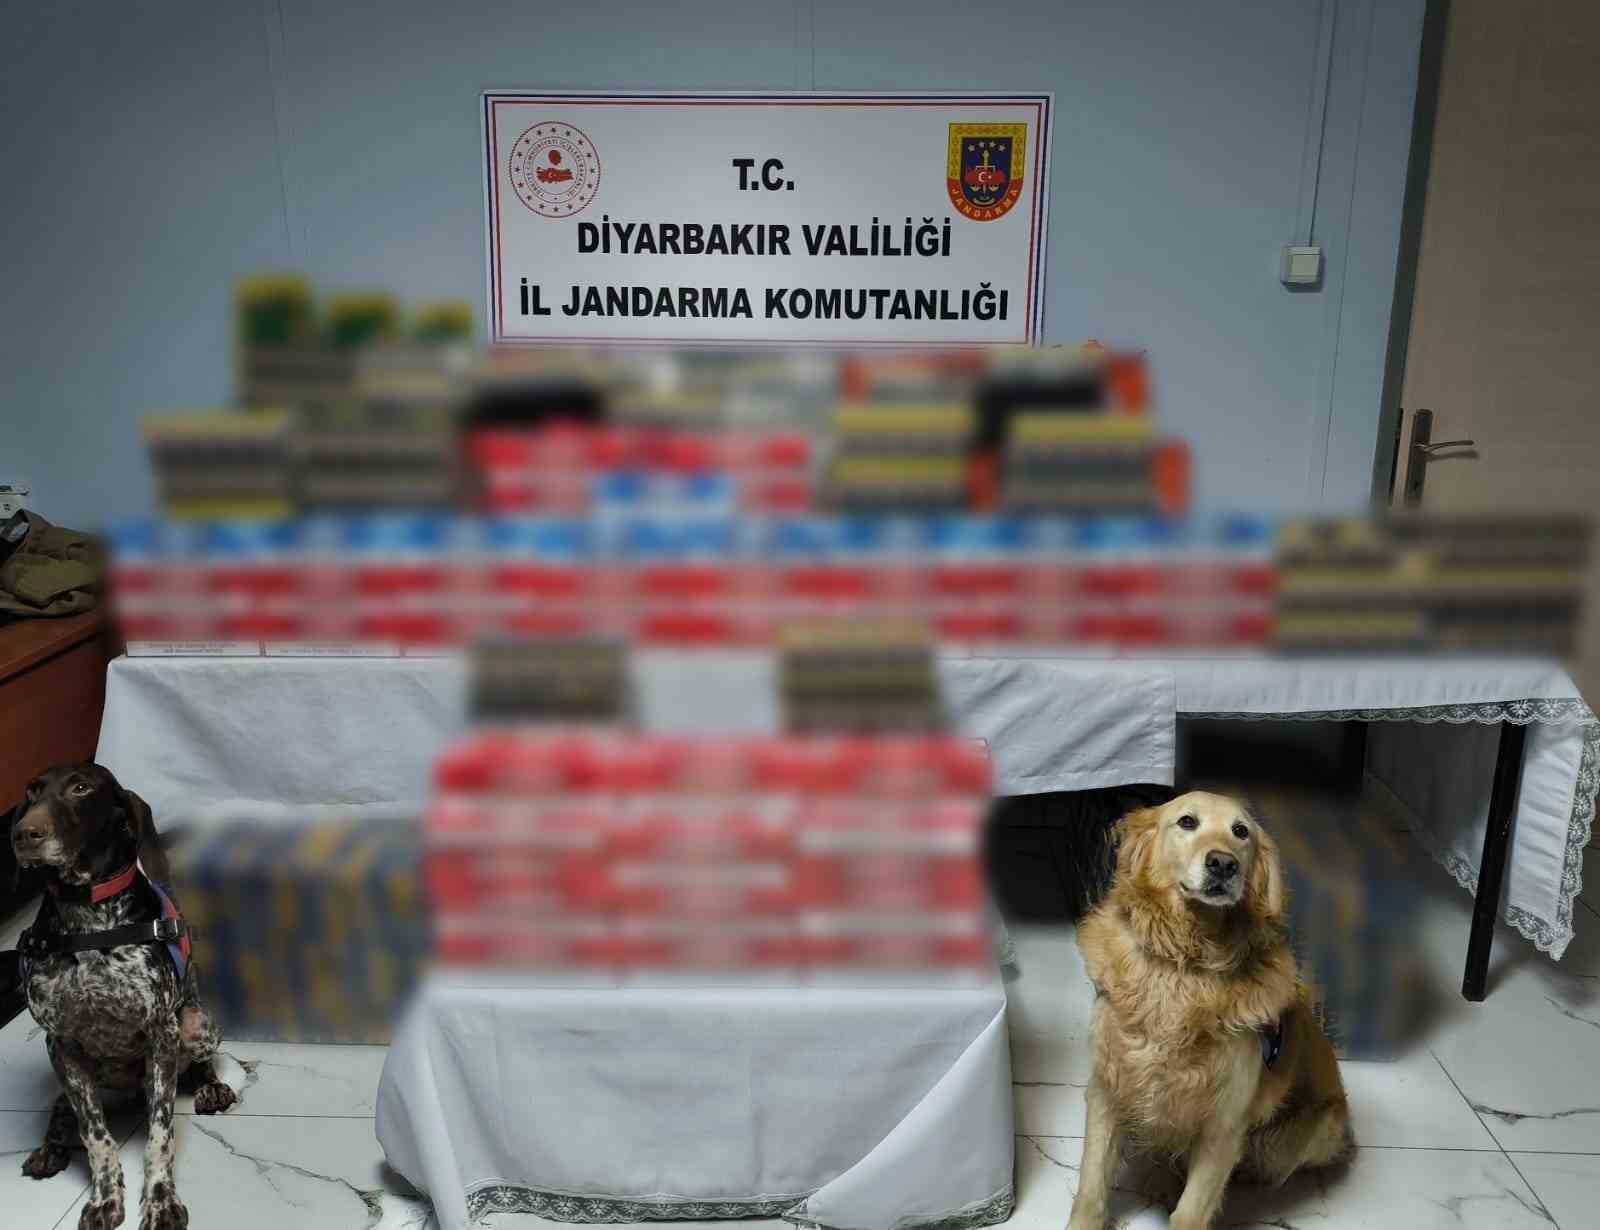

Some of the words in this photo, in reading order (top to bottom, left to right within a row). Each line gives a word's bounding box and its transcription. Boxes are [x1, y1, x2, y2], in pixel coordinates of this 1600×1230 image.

[733, 158, 795, 191] T.C.
[951, 187, 1019, 218] JANDARMA
[577, 214, 791, 256] DİYARBAKIR
[801, 216, 952, 257] VALİLİĞİ
[520, 277, 551, 317] İL
[562, 286, 753, 319] JANDARMA
[765, 281, 1009, 321] KOMUTANLIĞI
